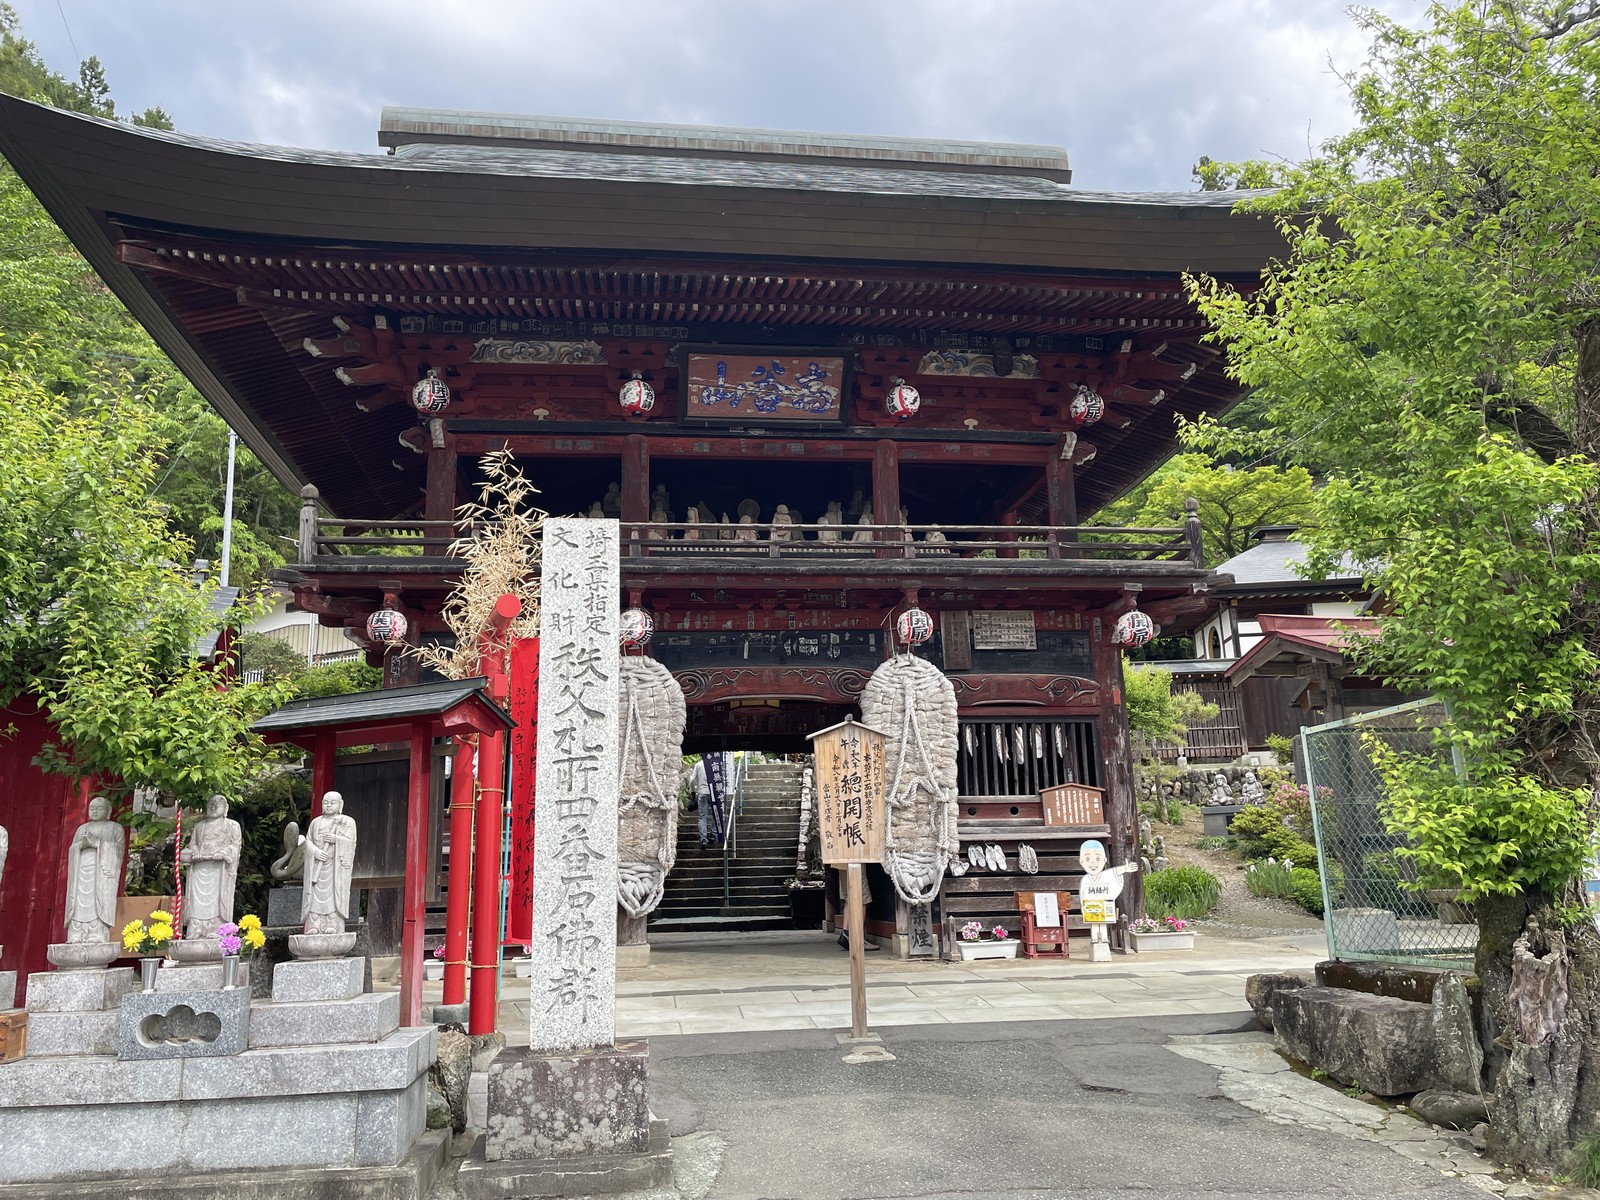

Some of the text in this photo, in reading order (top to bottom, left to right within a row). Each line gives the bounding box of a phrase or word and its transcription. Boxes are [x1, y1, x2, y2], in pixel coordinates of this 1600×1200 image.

[548, 526, 579, 636] 文化財
[582, 527, 613, 636] 埼玉県指定
[910, 611, 929, 640] 開扉
[1130, 613, 1149, 644] 開扉
[850, 736, 860, 770] 令和八年
[841, 771, 866, 848] 總開帳
[910, 902, 933, 949] 禁煙
